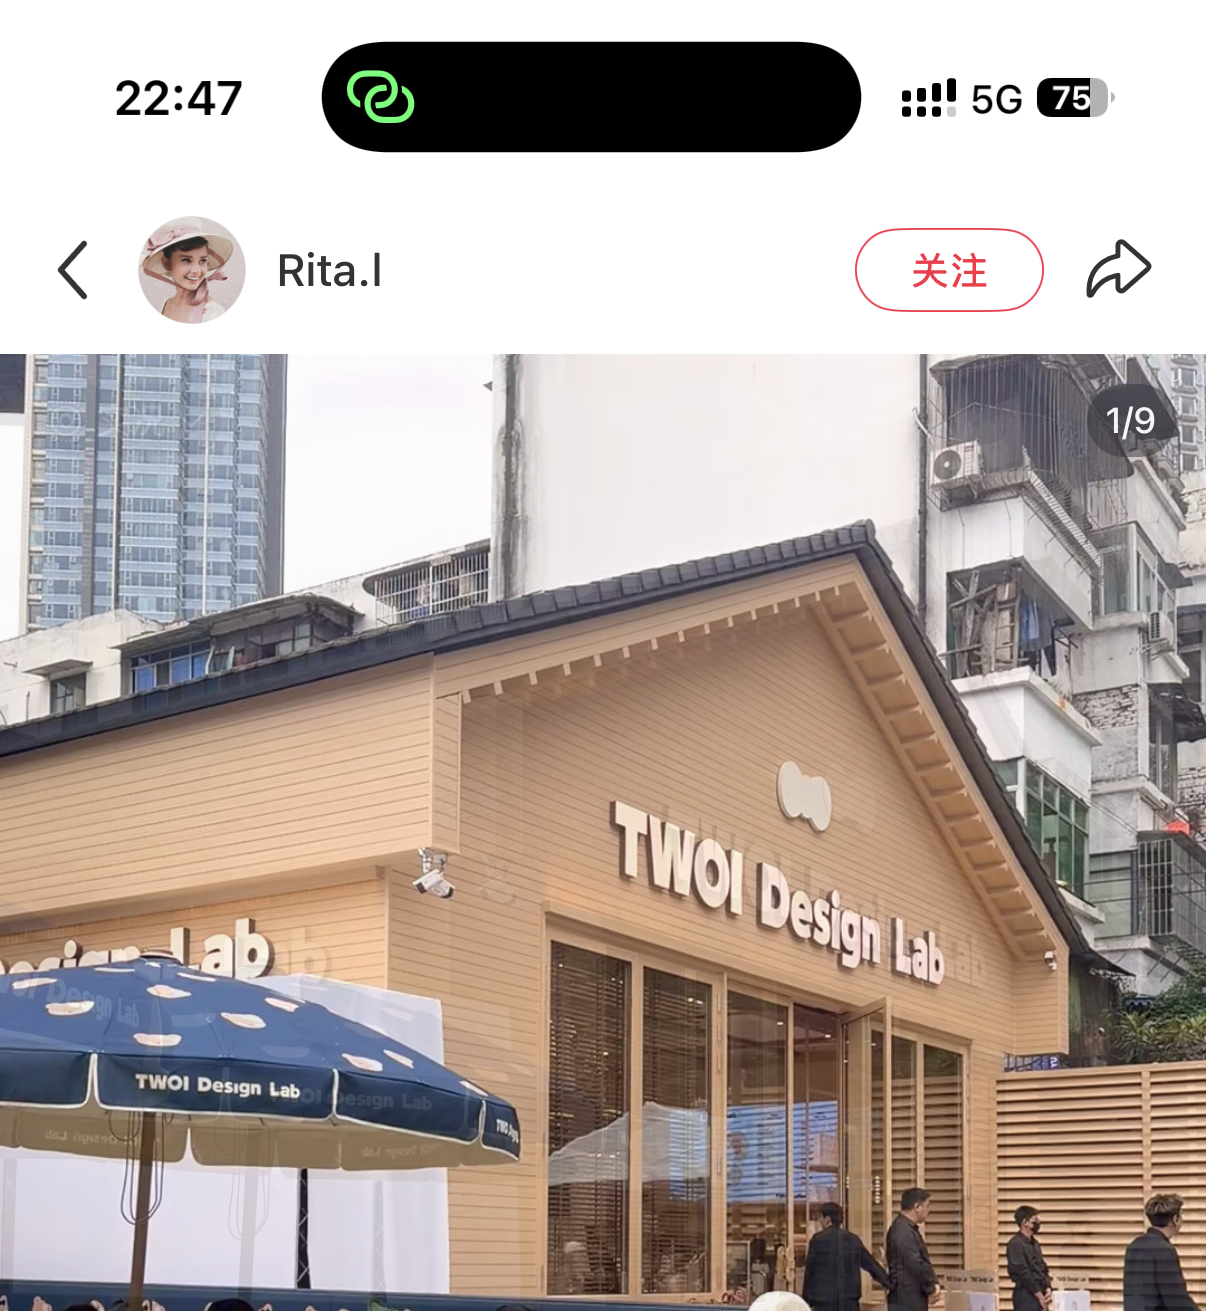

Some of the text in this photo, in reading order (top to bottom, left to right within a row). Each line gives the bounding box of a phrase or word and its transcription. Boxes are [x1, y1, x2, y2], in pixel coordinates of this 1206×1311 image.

[610, 800, 743, 916] TWOI
[757, 862, 881, 969] Design
[891, 917, 946, 986] Lab
[135, 1073, 190, 1092] TWOI
[197, 1077, 262, 1097] Design
[269, 1081, 301, 1099] Lab
